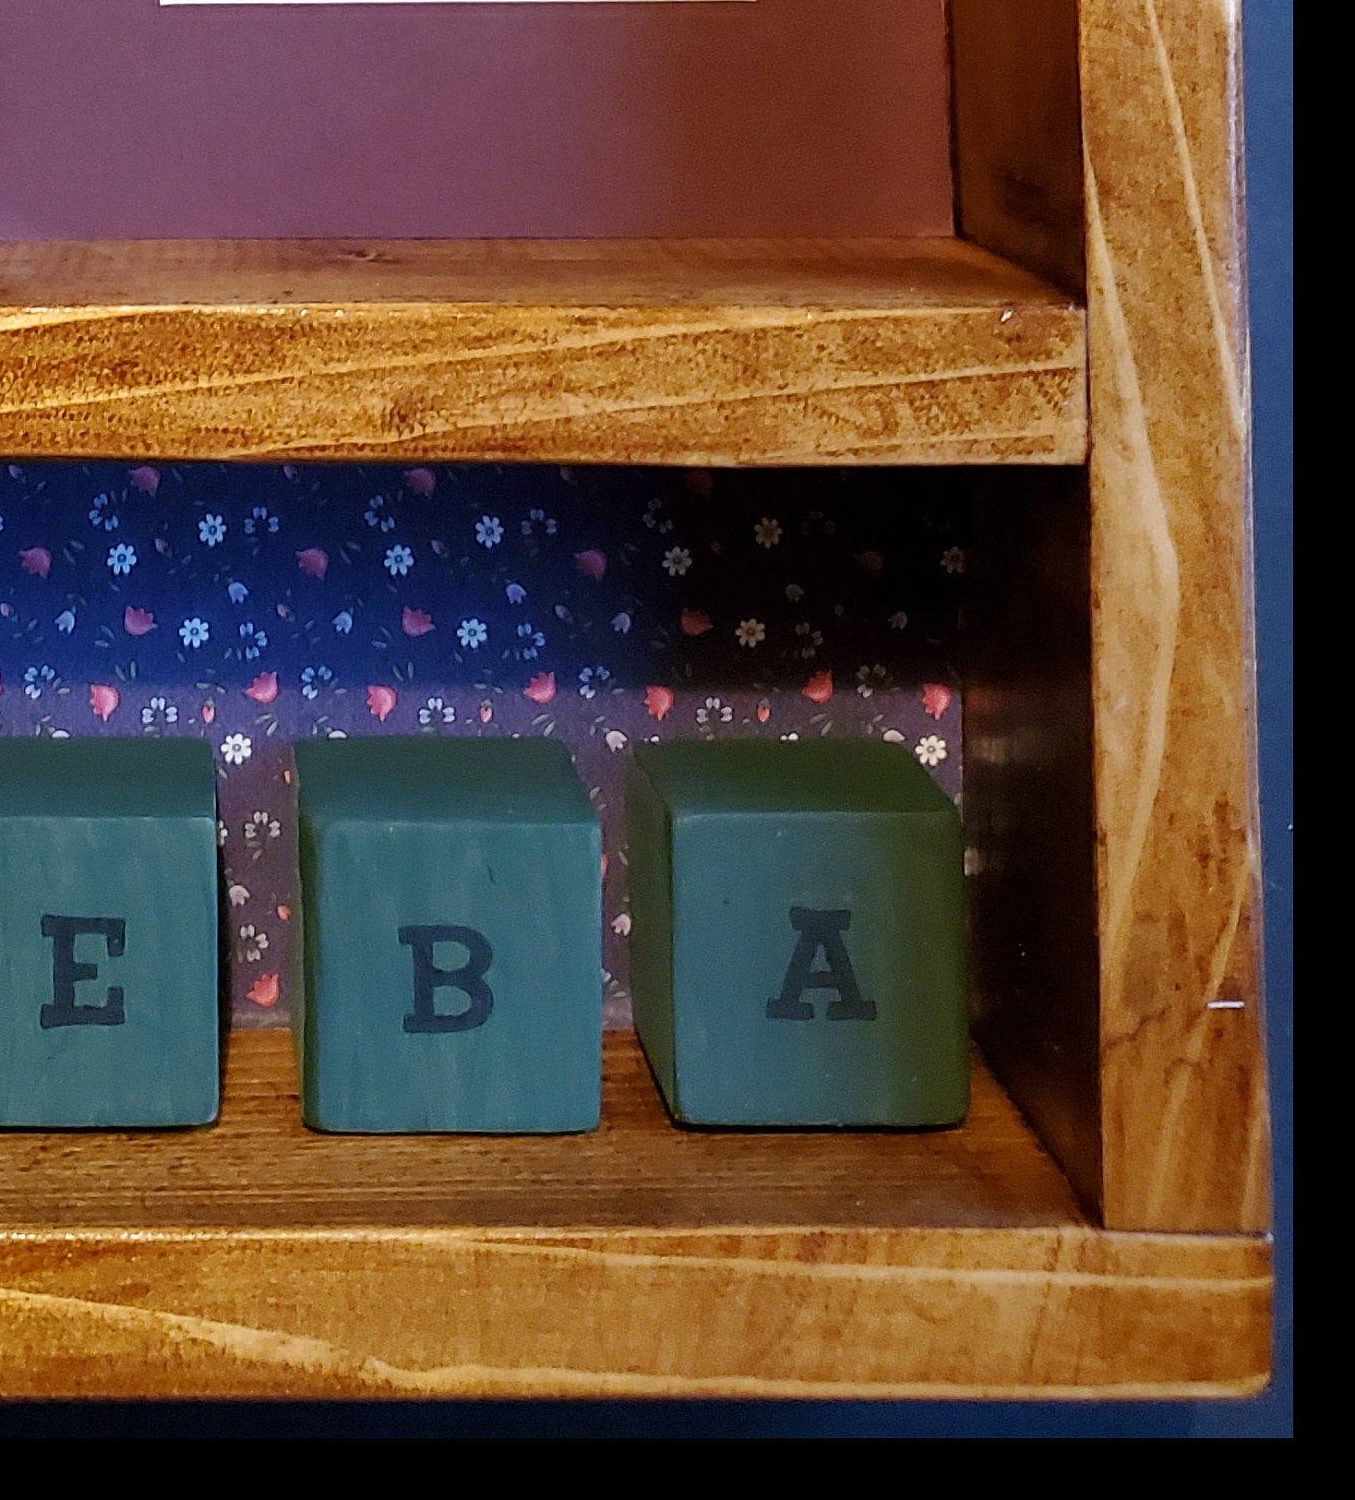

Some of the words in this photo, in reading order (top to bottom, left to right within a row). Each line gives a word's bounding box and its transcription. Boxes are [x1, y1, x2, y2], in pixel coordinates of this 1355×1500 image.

[40, 914, 126, 1029] E
[398, 924, 494, 1034] B
[765, 906, 877, 1021] A
